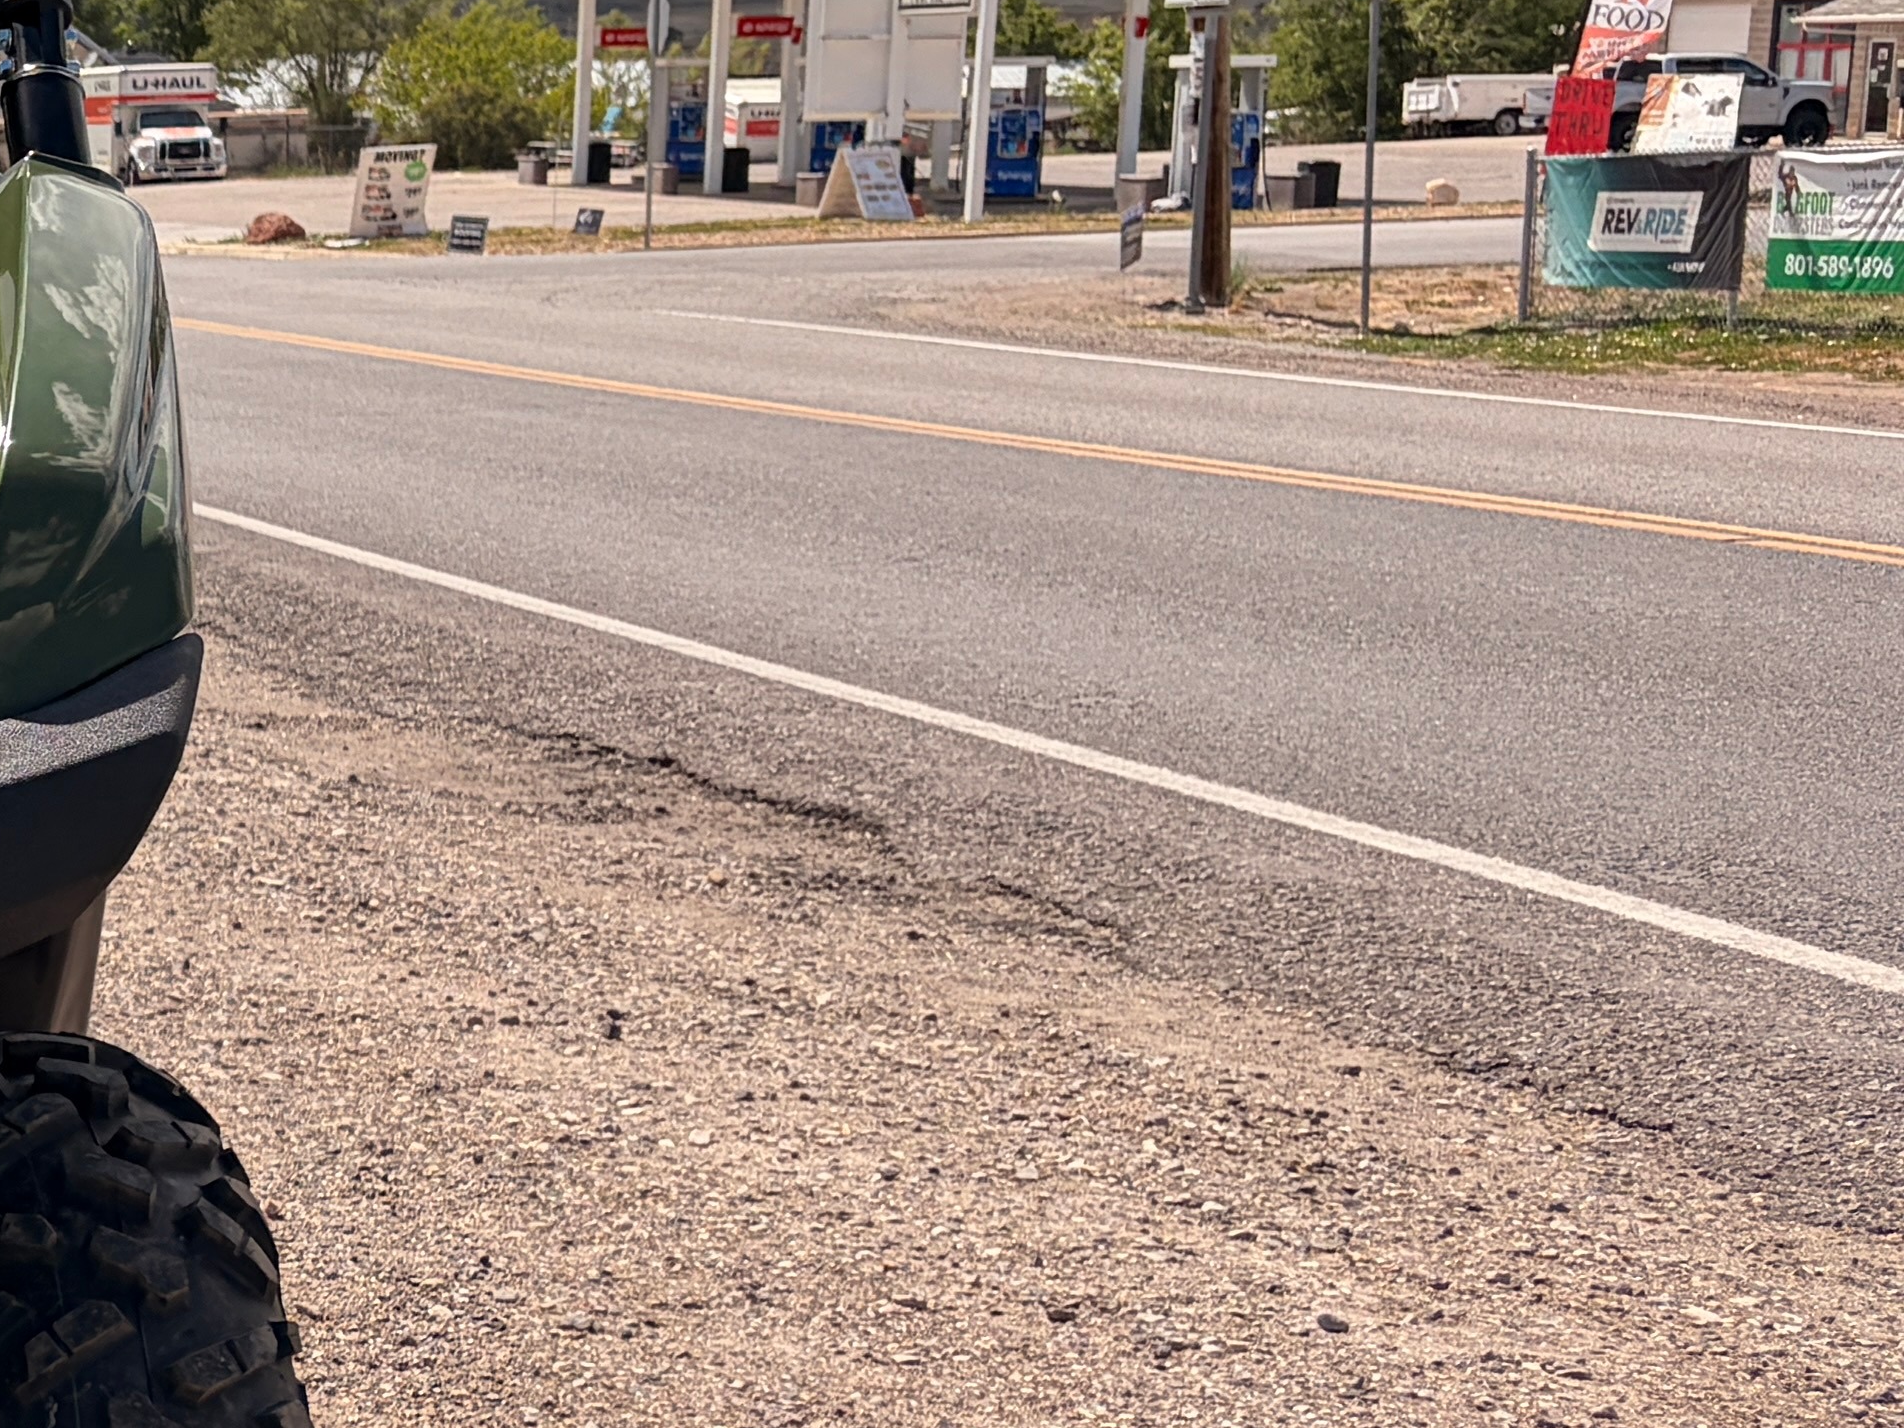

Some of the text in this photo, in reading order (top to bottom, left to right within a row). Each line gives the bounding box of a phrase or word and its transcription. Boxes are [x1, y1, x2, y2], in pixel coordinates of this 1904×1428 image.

[1593, 4, 1665, 30] FOOD
[132, 76, 206, 91] U-HAUL
[1559, 80, 1616, 106] DRIVE
[1553, 112, 1606, 138] THRU
[1784, 253, 1895, 280] 801-589-1896
